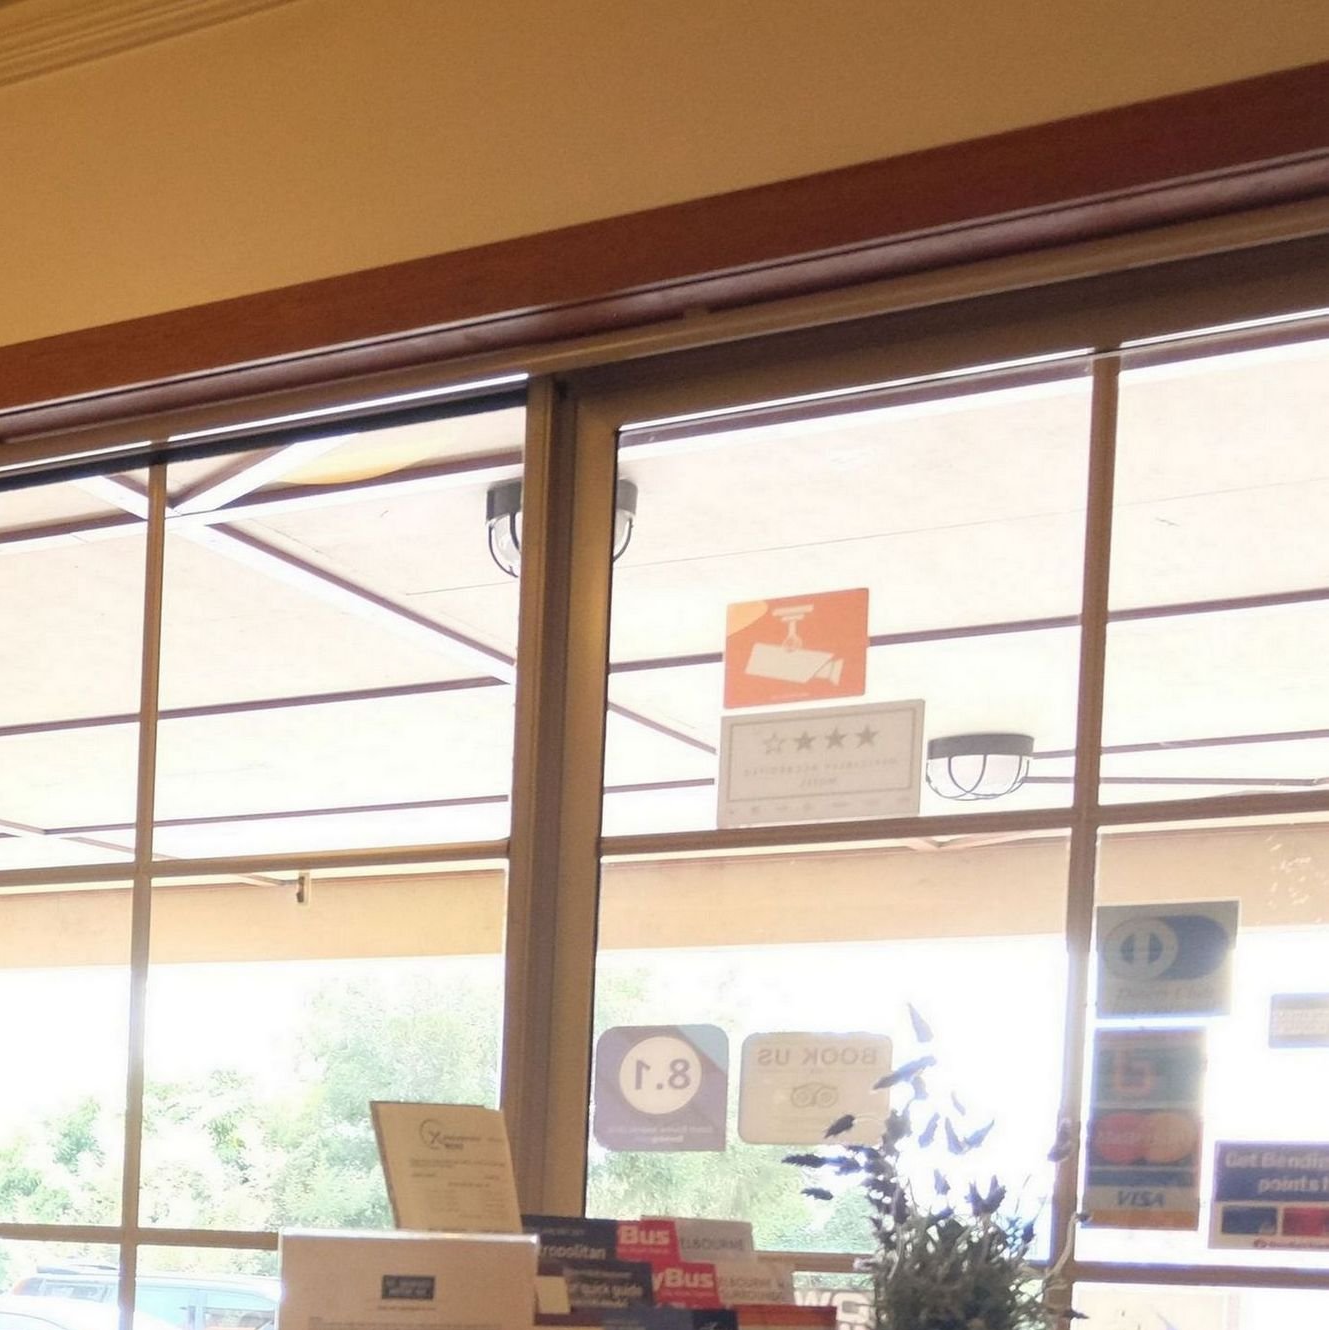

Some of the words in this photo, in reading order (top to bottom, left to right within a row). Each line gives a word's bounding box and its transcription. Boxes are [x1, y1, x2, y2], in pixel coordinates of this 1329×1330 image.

[1226, 1152, 1258, 1168] Get
[1261, 1151, 1329, 1169] Bendi
[1258, 1176, 1321, 1194] points
[1117, 1191, 1165, 1208] VISA
